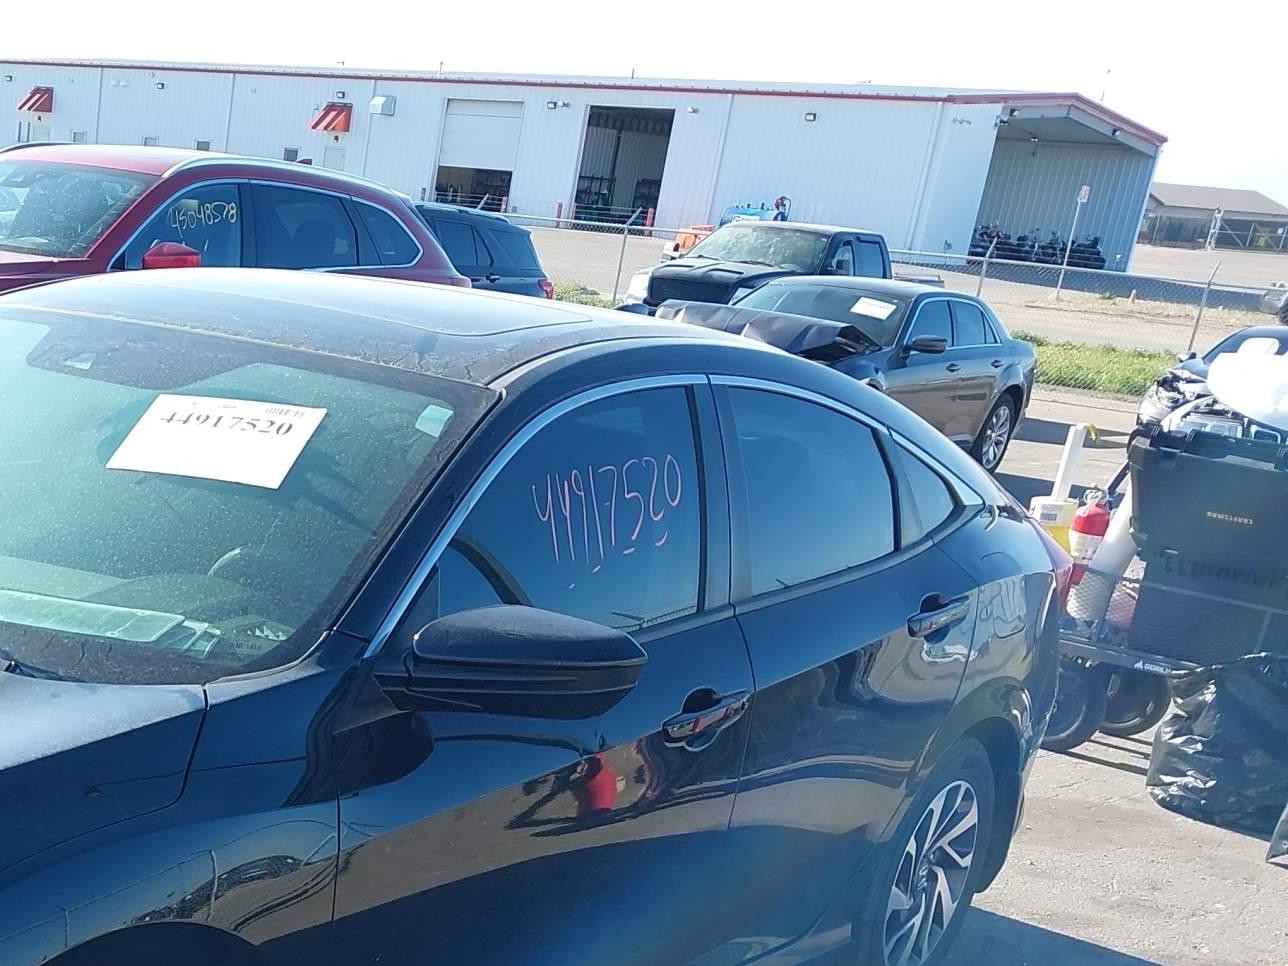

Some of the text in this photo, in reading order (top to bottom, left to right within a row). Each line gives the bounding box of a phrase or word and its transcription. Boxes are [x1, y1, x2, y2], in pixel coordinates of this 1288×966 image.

[167, 201, 237, 239] 45048578
[160, 411, 294, 436] 44917520
[531, 454, 682, 565] 44917520
